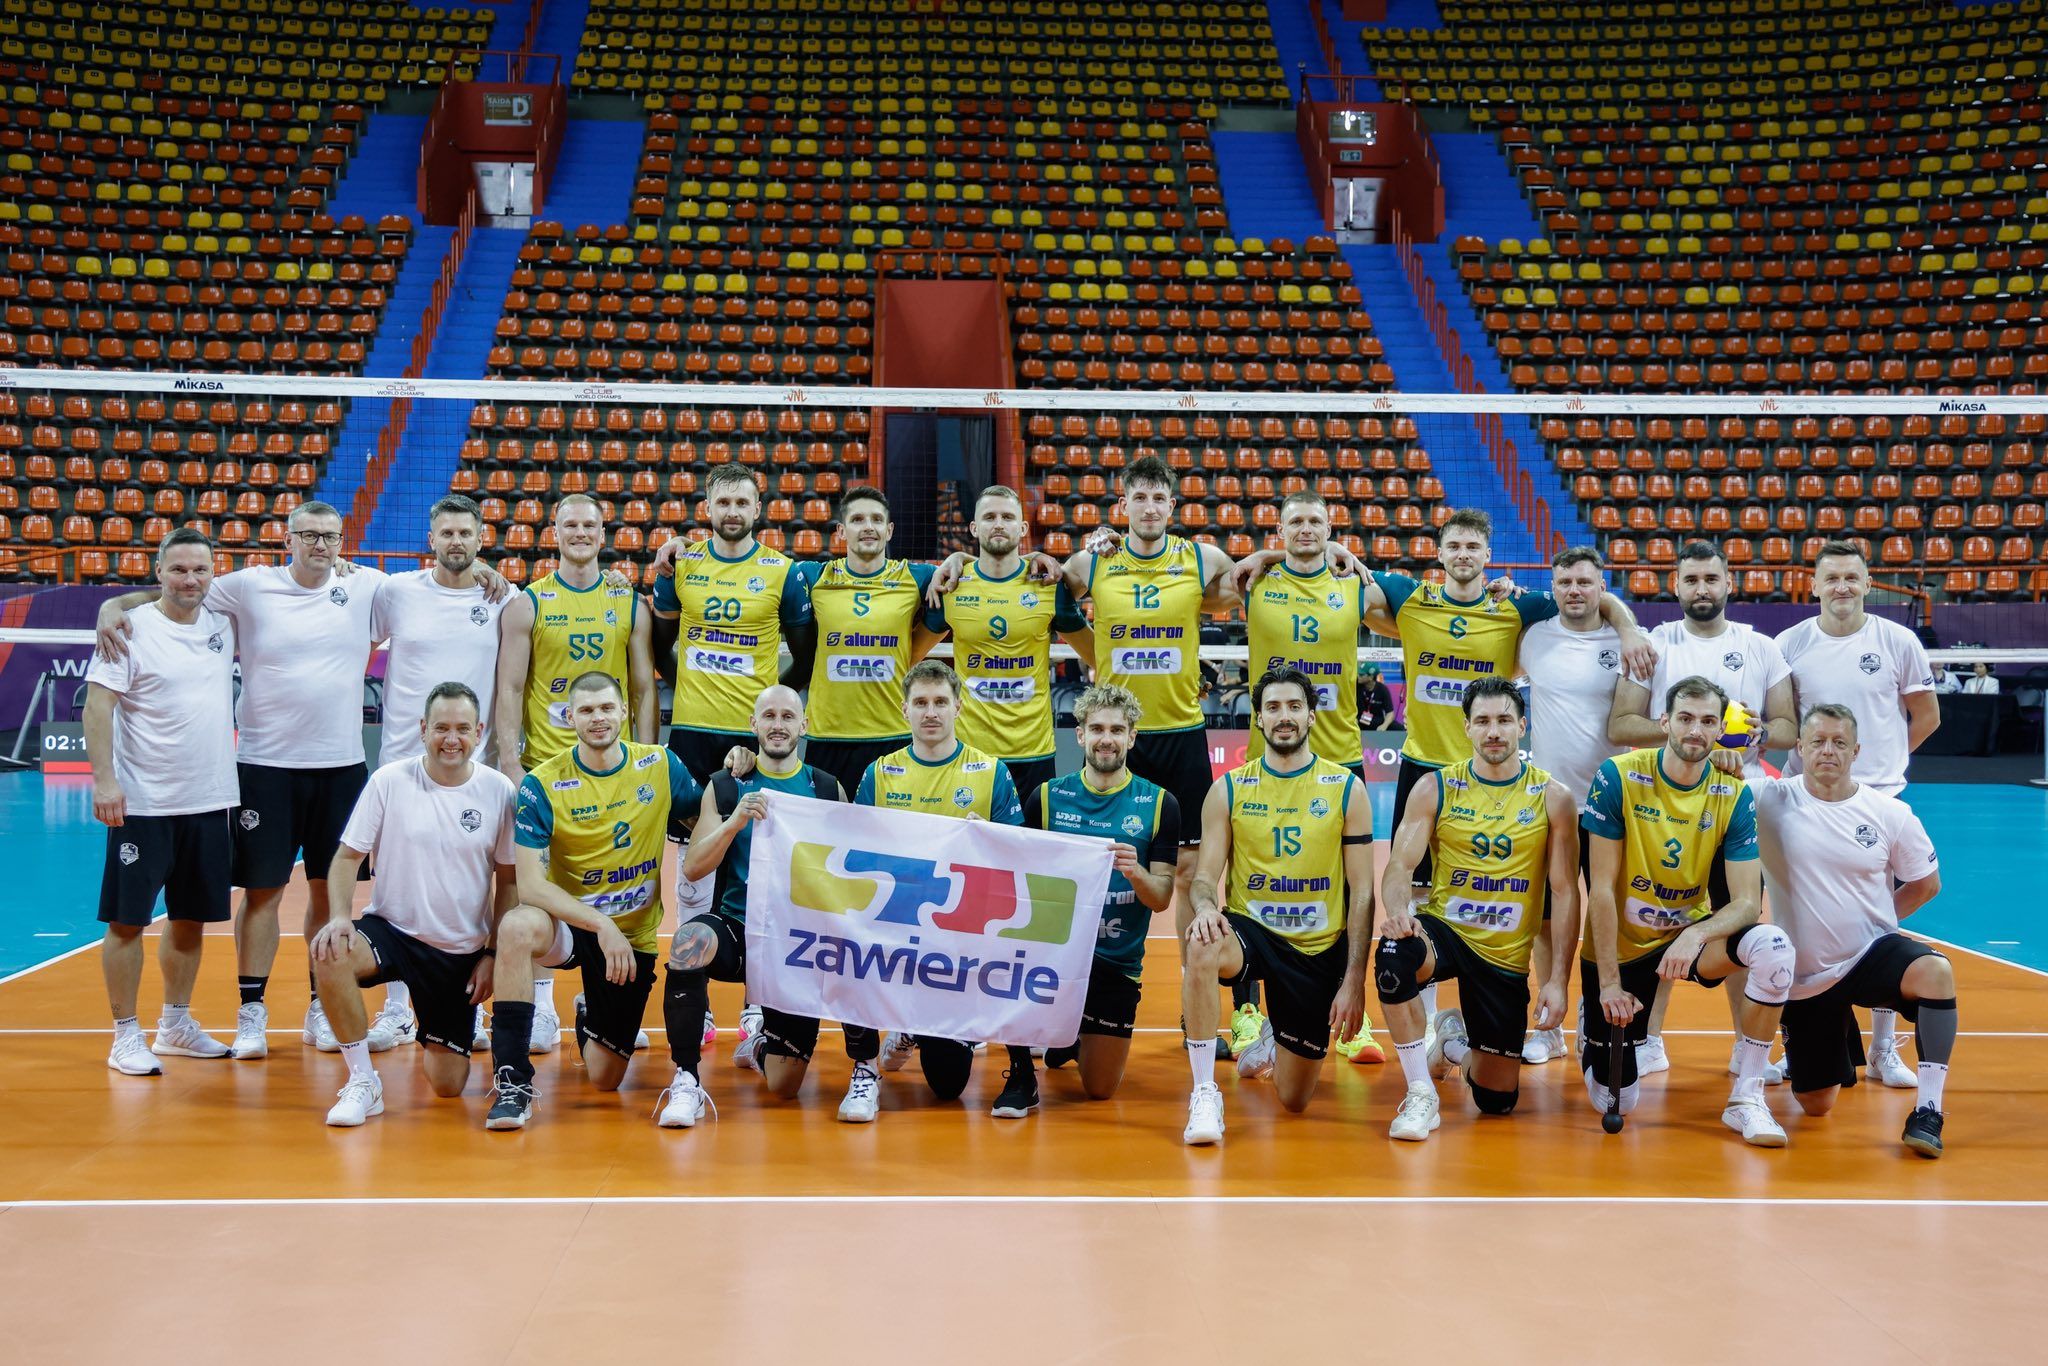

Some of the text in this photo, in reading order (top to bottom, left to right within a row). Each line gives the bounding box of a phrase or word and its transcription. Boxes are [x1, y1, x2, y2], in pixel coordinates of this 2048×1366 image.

[512, 97, 529, 117] D
[852, 592, 871, 617] 5
[1132, 583, 1161, 609] 12
[703, 596, 742, 622] 20
[705, 629, 759, 647] aluron
[988, 615, 1008, 641] 9
[1131, 624, 1184, 639] aluron
[1291, 614, 1320, 643] 13
[1449, 615, 1468, 640] 6
[568, 633, 605, 662] 55
[844, 632, 899, 648] aluron
[695, 651, 743, 673] CMC
[836, 658, 885, 678] CMC
[984, 655, 1035, 670] aluron
[1121, 650, 1171, 670] CMC
[1438, 655, 1495, 673] aluron
[975, 681, 1024, 699] CMC
[1425, 680, 1468, 702] CM
[45, 735, 88, 751] 02:1
[638, 754, 657, 768] CMC
[966, 762, 986, 771] CMC
[1321, 775, 1344, 783] CMC
[612, 821, 632, 849] 2
[1272, 825, 1303, 858] 15
[1470, 832, 1513, 863] 99
[1660, 838, 1683, 869] 3
[1270, 876, 1331, 893] aluron
[1471, 875, 1530, 893] aluron
[1652, 883, 1701, 901] luron
[593, 886, 647, 912] CMC
[1105, 890, 1136, 905] ron
[1260, 905, 1317, 928] CMC
[1458, 903, 1514, 928] CMC
[785, 928, 1060, 1005] zawiercie
